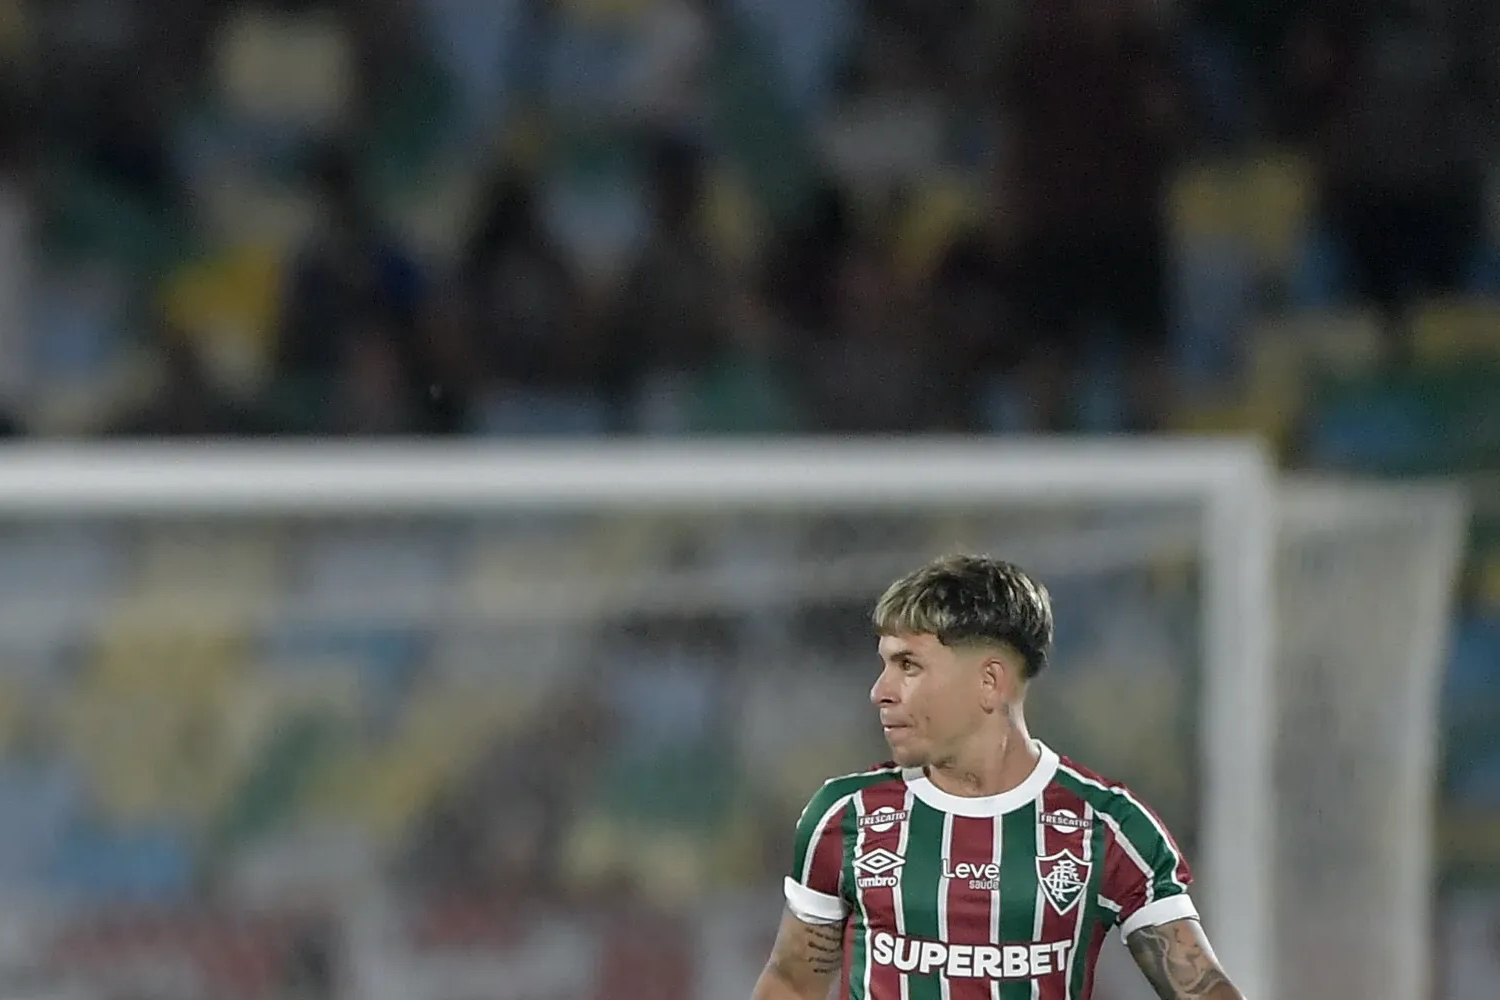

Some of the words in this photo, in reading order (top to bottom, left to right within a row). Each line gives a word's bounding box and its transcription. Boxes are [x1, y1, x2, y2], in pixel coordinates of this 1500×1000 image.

[859, 812, 906, 827] FRESCATTO
[1040, 813, 1090, 829] FRESCATTO
[942, 859, 1000, 879] Leve
[857, 874, 897, 887] umbro
[968, 877, 1000, 890] saúde
[871, 932, 1073, 979] SUPERBET
